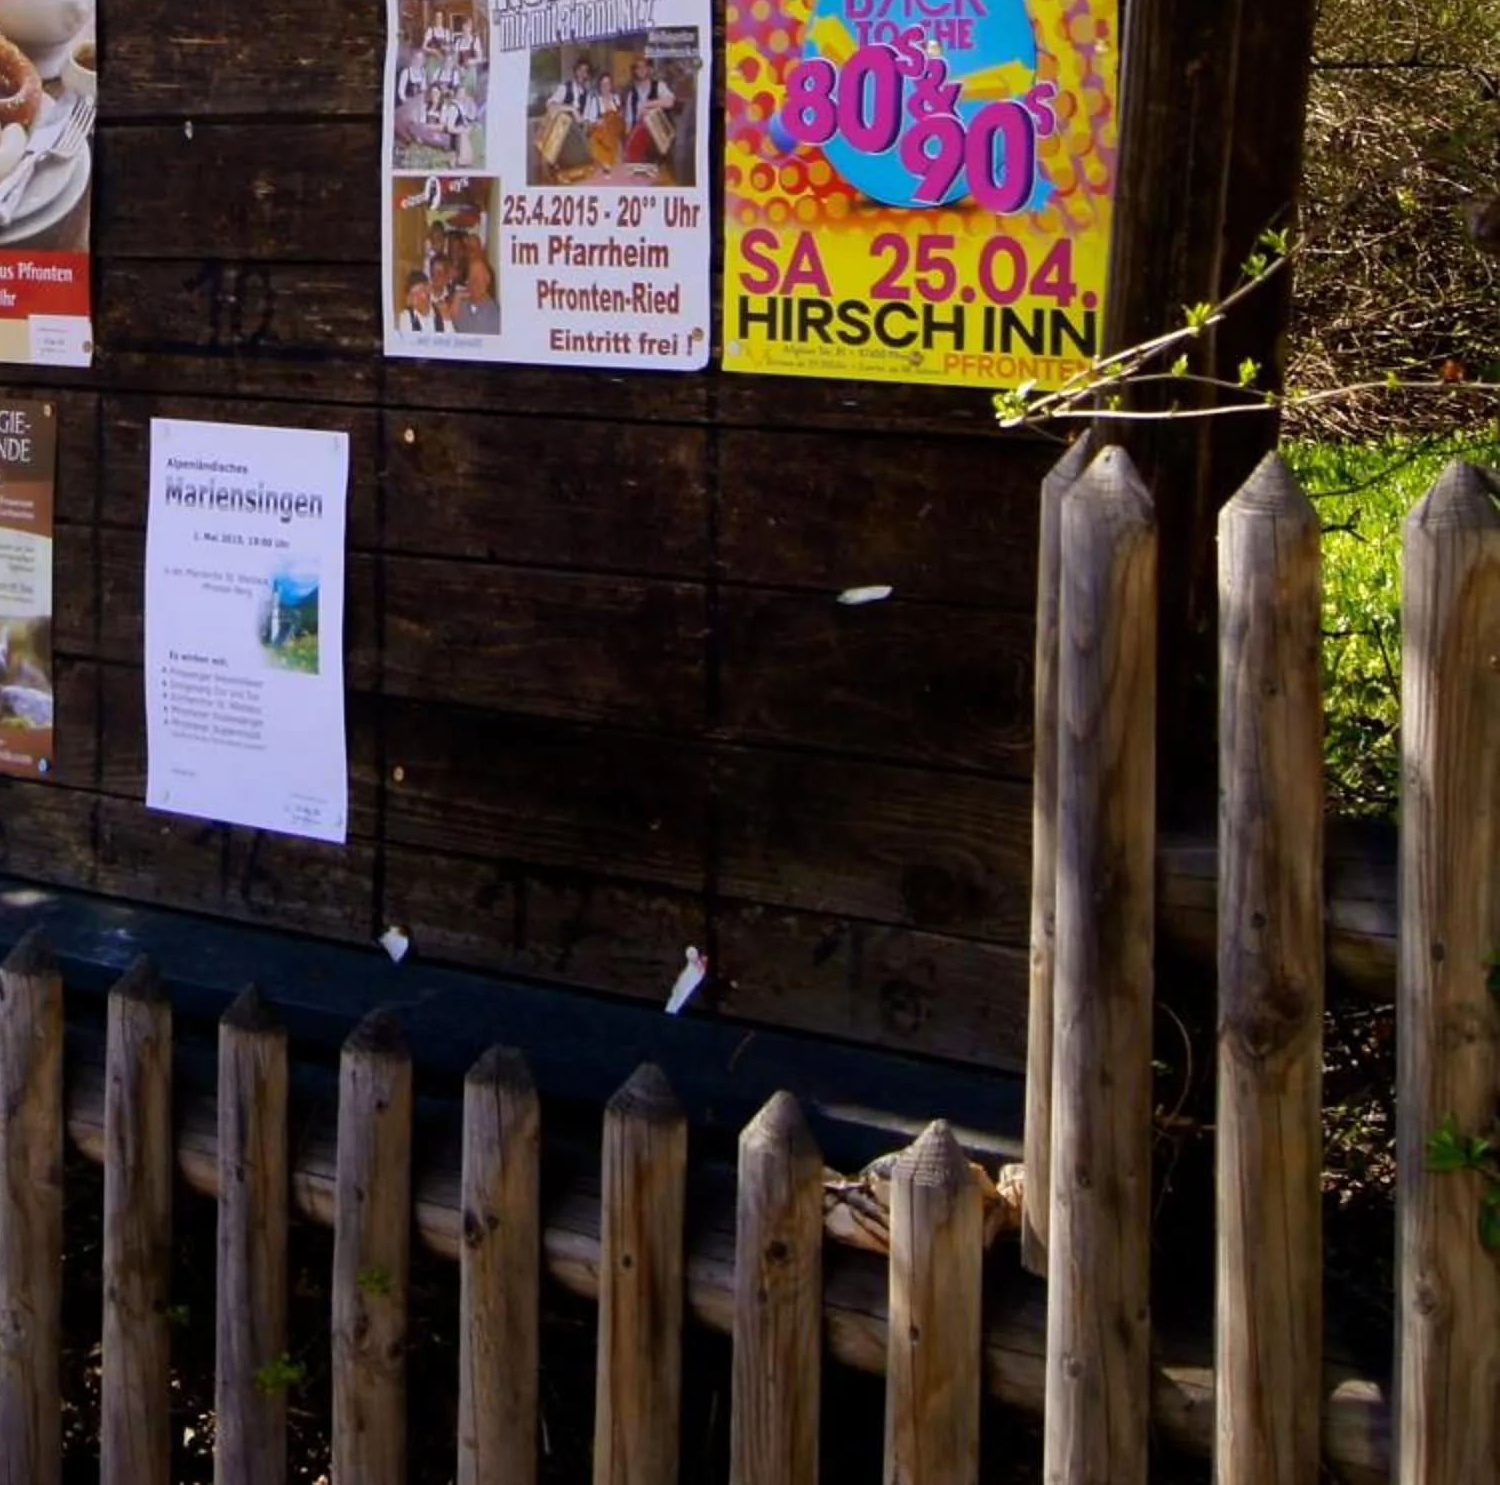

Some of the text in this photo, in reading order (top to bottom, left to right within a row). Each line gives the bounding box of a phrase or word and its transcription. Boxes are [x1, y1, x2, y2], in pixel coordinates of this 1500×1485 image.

[503, 194, 598, 226] 25.4.2015
[664, 195, 699, 228] Uhr
[511, 234, 669, 268] im Pfarrheim
[739, 227, 1099, 309] SA 25.04.
[18, 261, 73, 284] Pfronten
[537, 279, 680, 314] Pfronten-Ried
[550, 327, 693, 356] Eintritt frei !
[738, 294, 1097, 357] HIRSCH INN
[167, 458, 248, 474] Alpenländisches
[165, 476, 323, 523] Mariensingen
